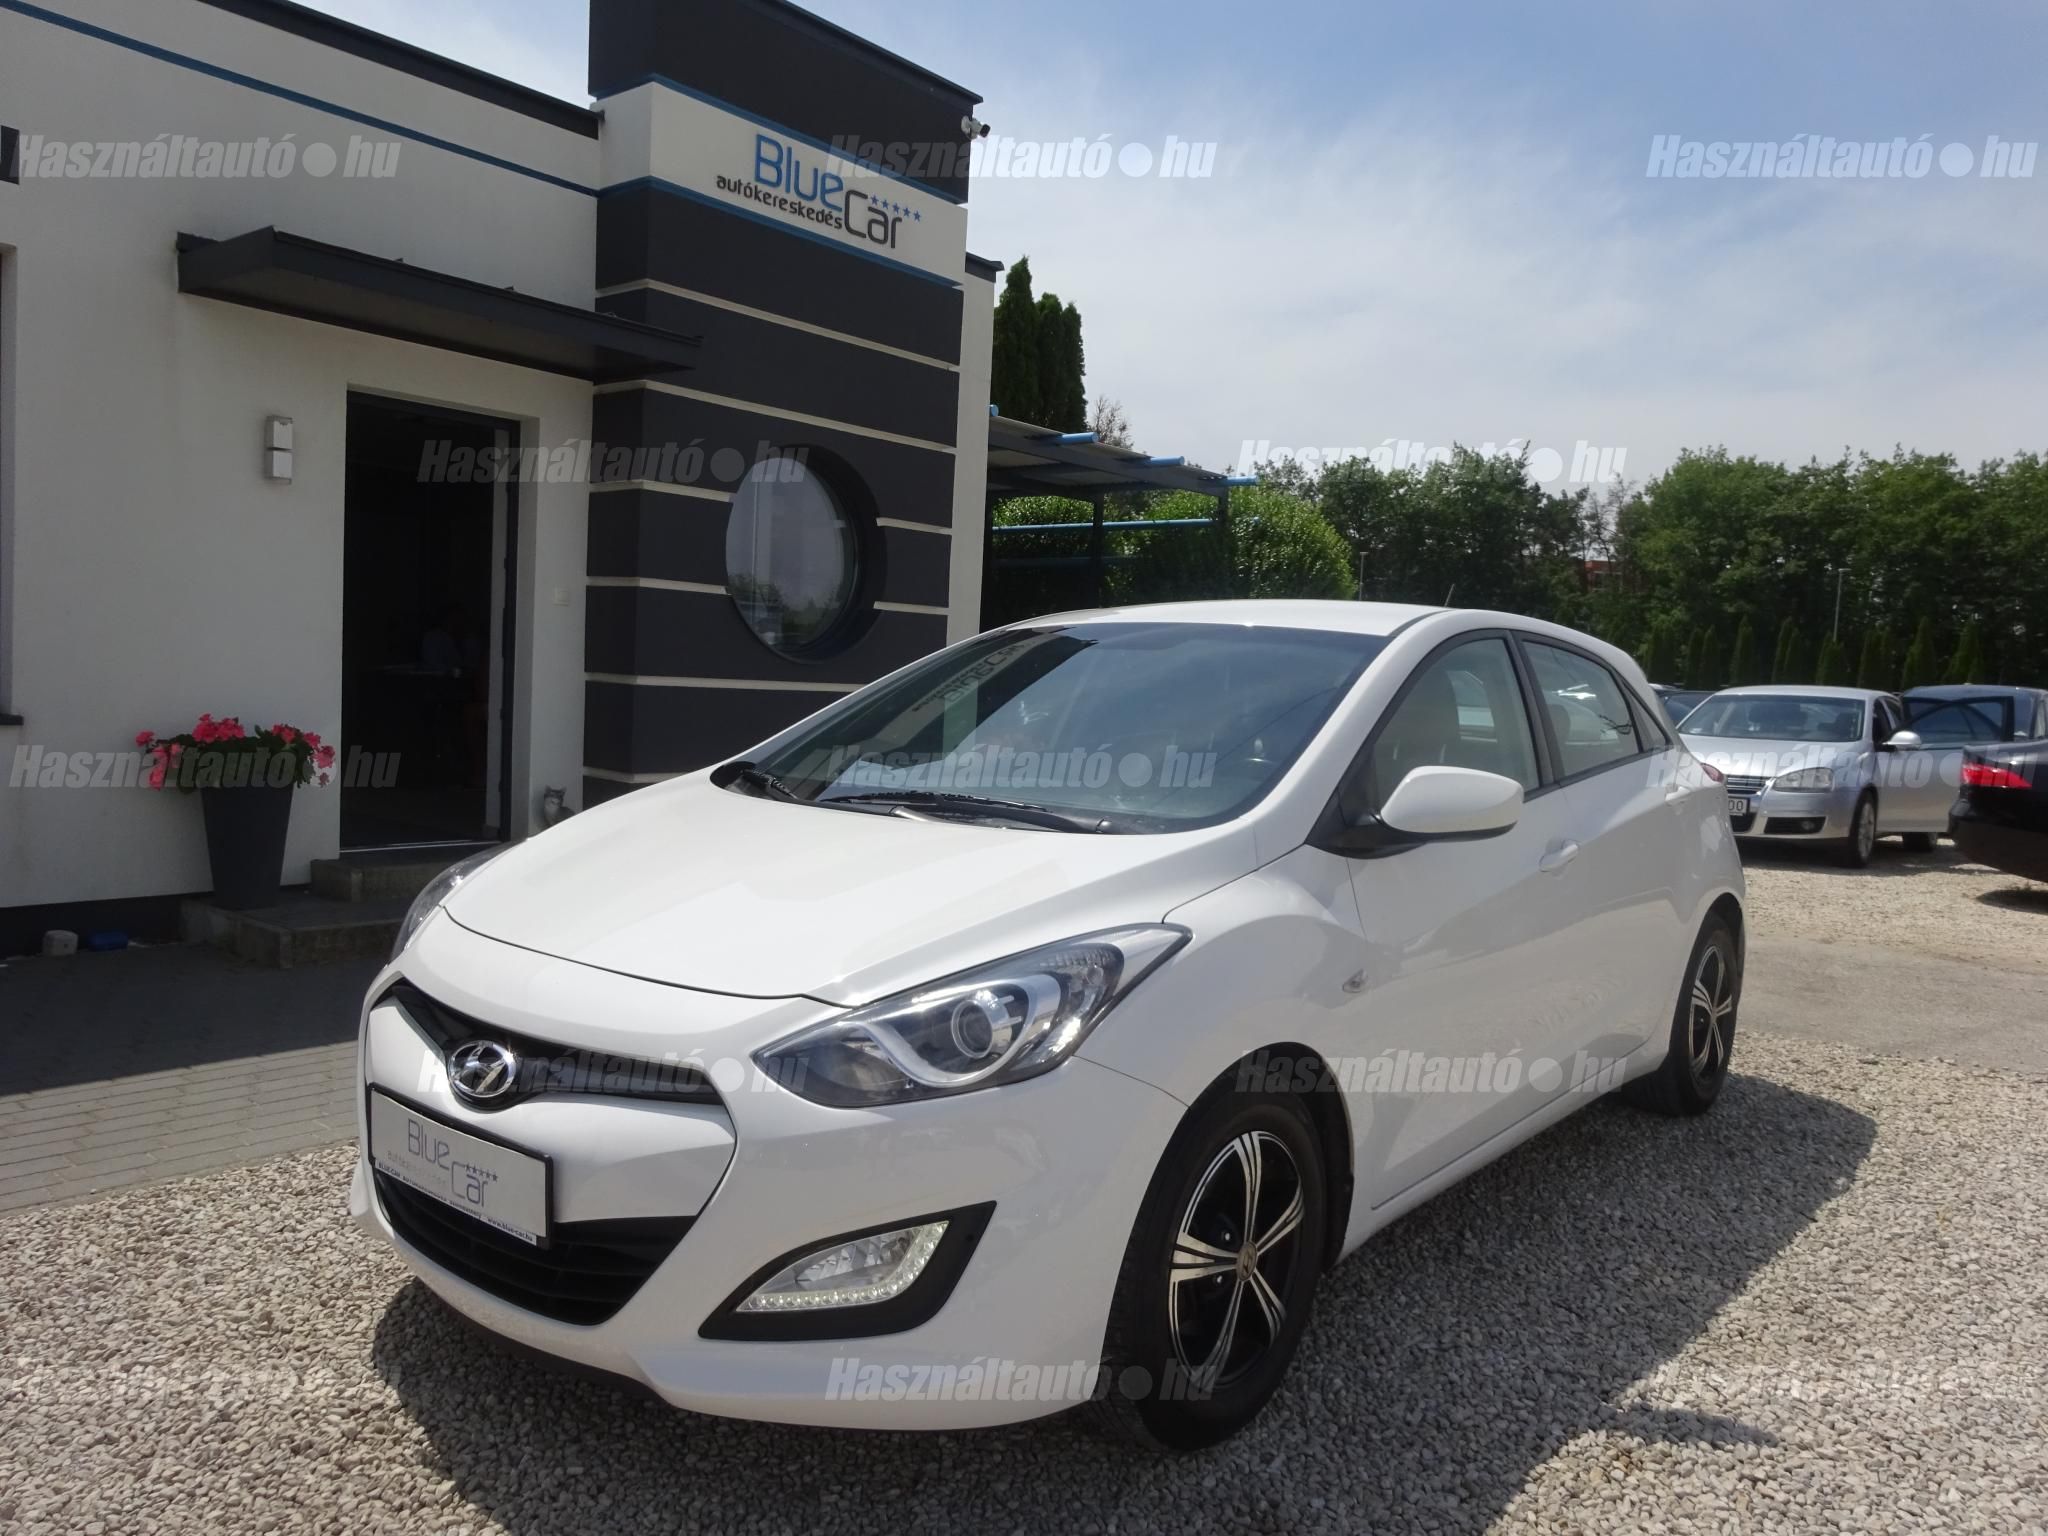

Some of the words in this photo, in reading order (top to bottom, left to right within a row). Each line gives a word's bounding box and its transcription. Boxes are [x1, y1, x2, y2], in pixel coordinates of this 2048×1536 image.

[755, 134, 843, 213] Blue
[716, 174, 843, 230] autókereskedés
[845, 189, 902, 249] Car
[408, 1118, 450, 1170] Blue
[452, 1161, 488, 1208] Car
